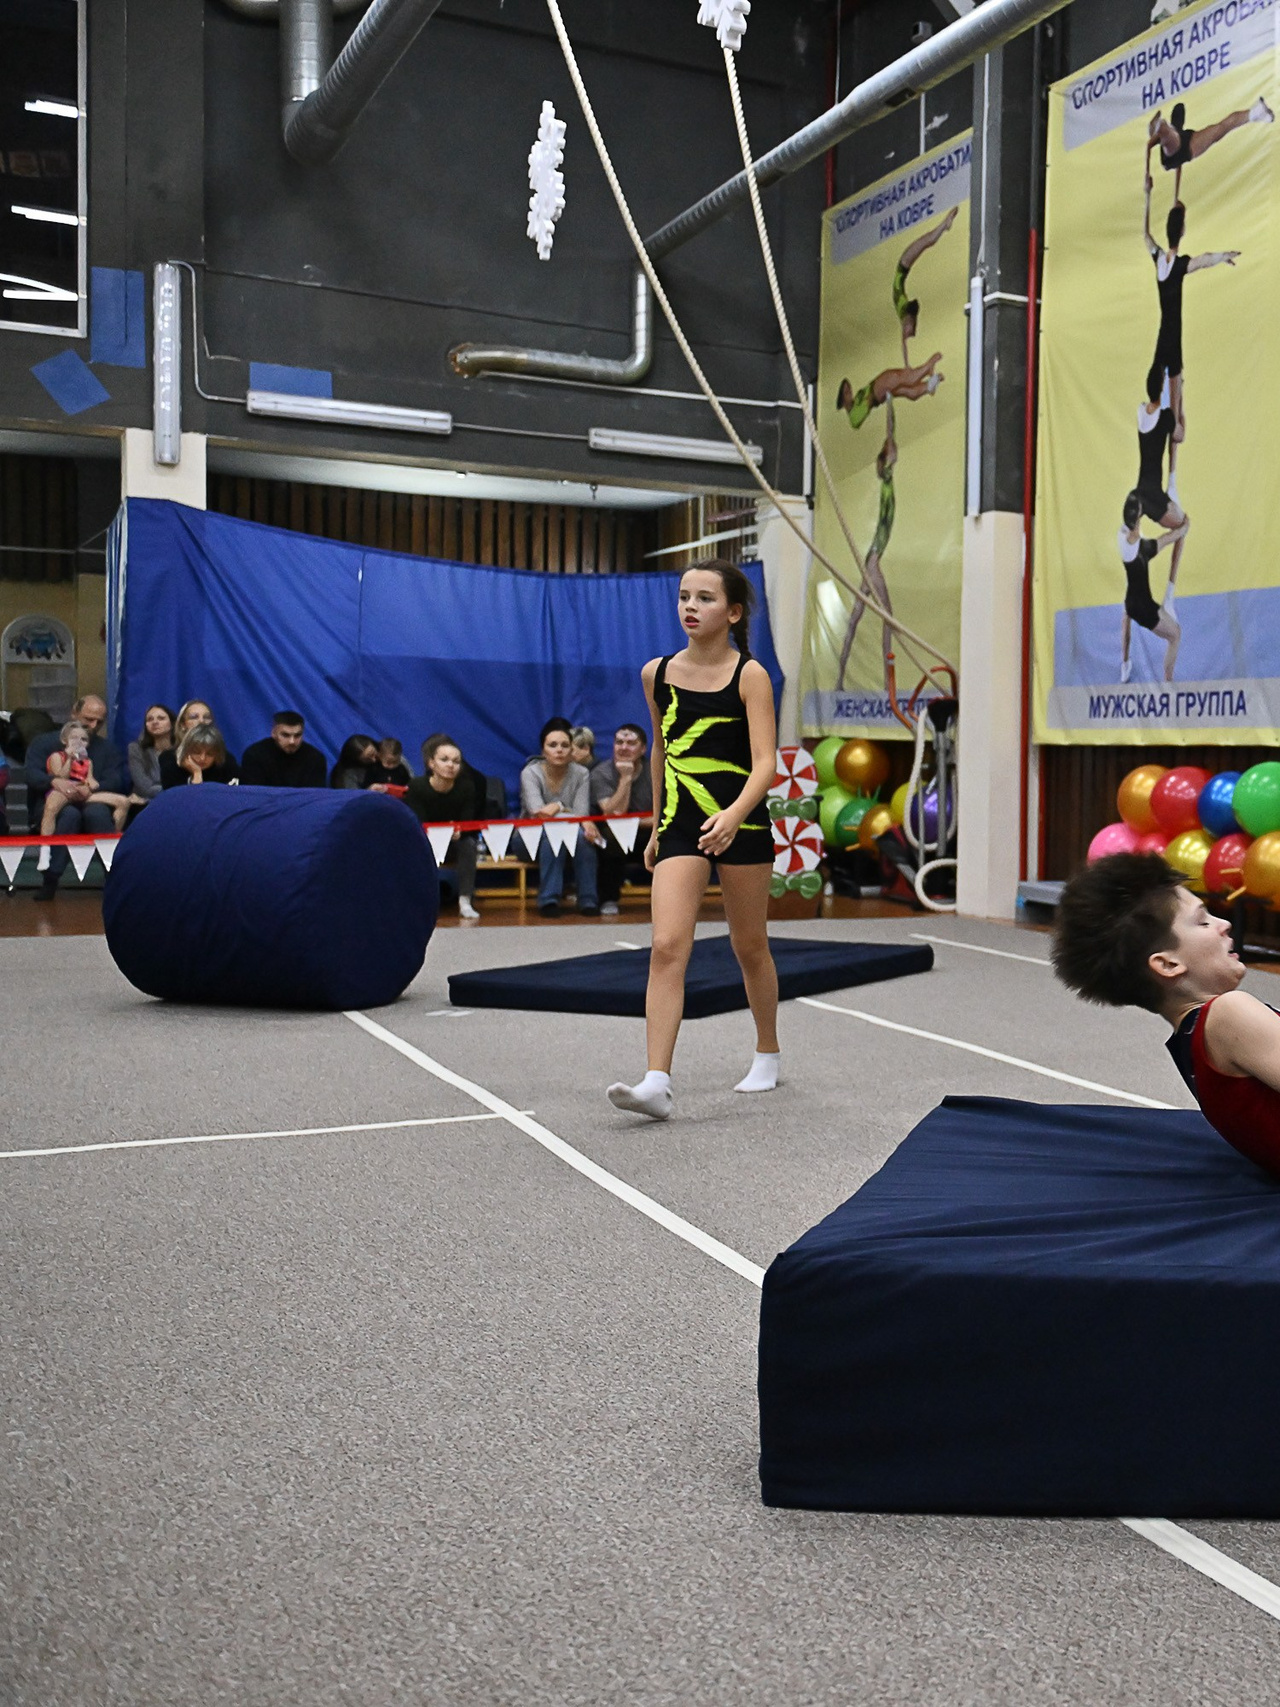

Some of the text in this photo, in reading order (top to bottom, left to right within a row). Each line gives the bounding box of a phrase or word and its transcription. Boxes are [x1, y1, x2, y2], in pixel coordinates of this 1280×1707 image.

[1071, 0, 1273, 110] СПОРТИВНАЯ АКРОБ
[1142, 41, 1231, 109] НА КОВРЕ
[835, 180, 906, 234] СПОРТИВНАЯ
[879, 193, 935, 240] НА КОВРЕ
[833, 697, 894, 719] ЖЕНСКАЯ
[1088, 689, 1248, 719] МУЖСКАЯ ГРУППА
